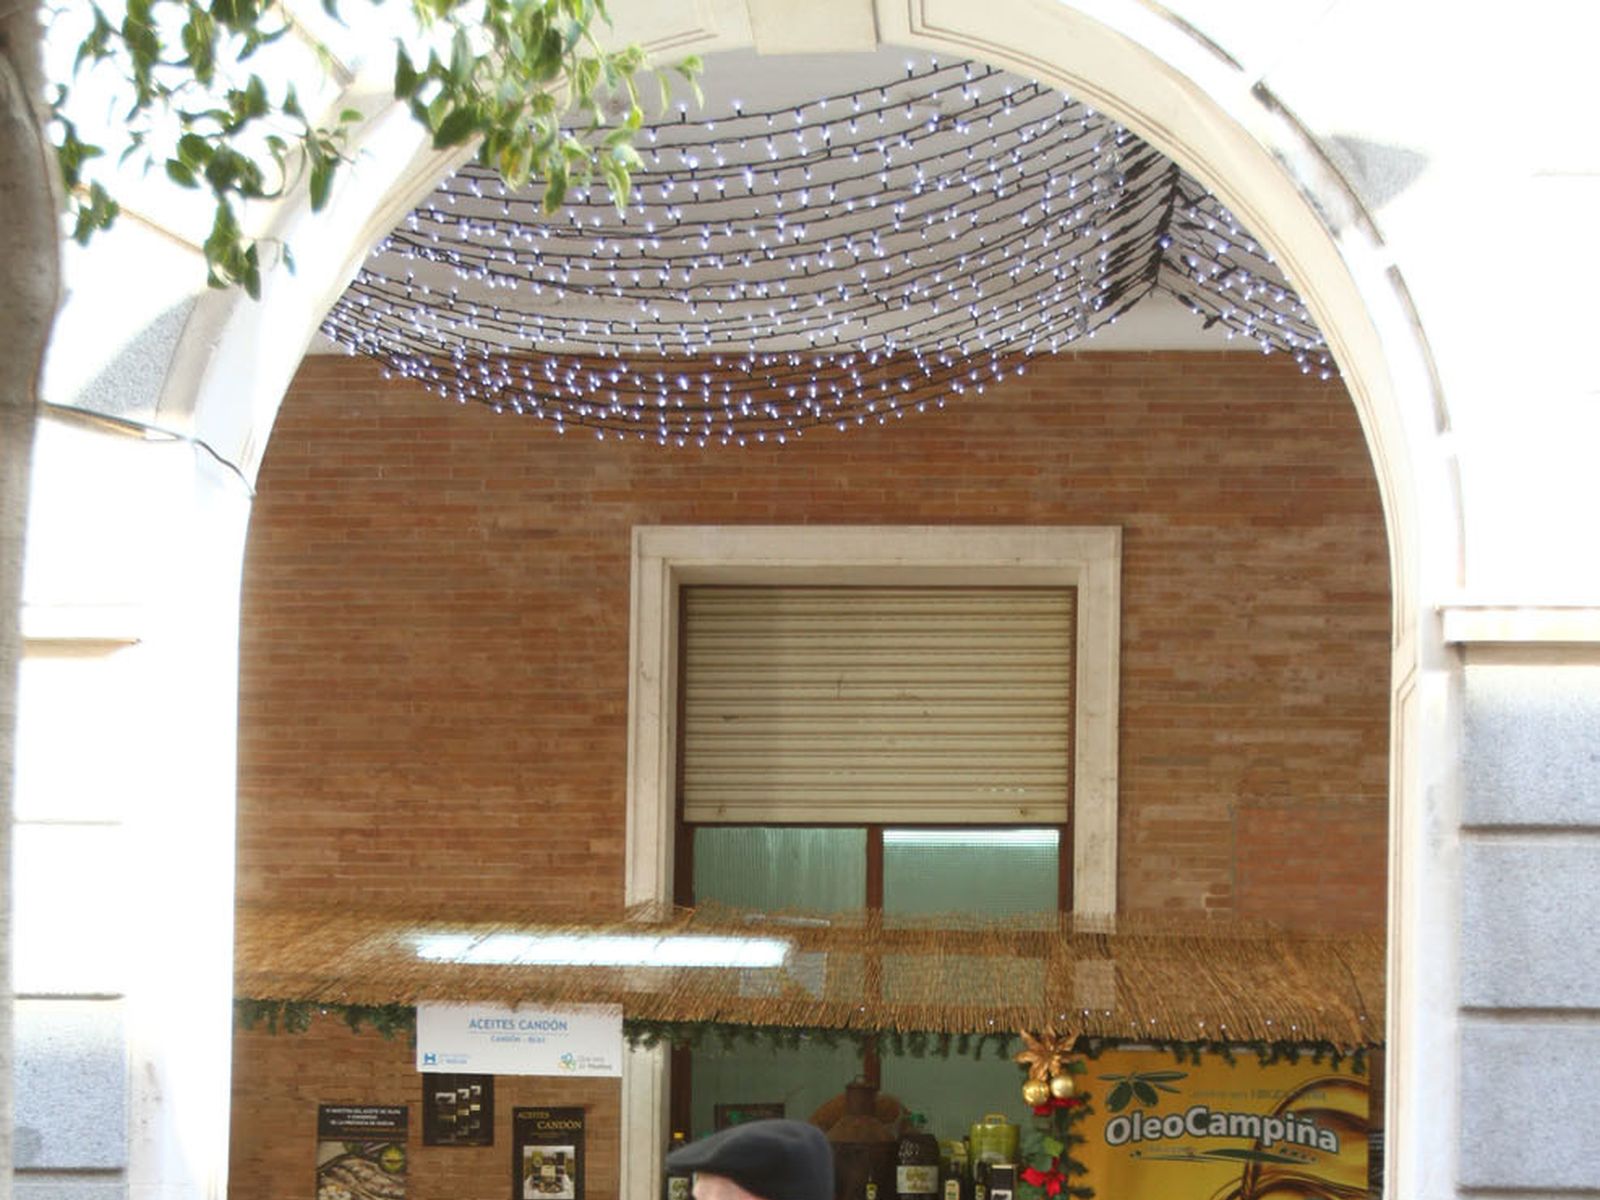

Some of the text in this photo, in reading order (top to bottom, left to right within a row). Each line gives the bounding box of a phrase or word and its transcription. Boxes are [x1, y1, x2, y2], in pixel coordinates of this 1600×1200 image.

[468, 1017, 568, 1031] ACEITES CANDÓN
[1105, 1106, 1340, 1154] OleoCampiña
